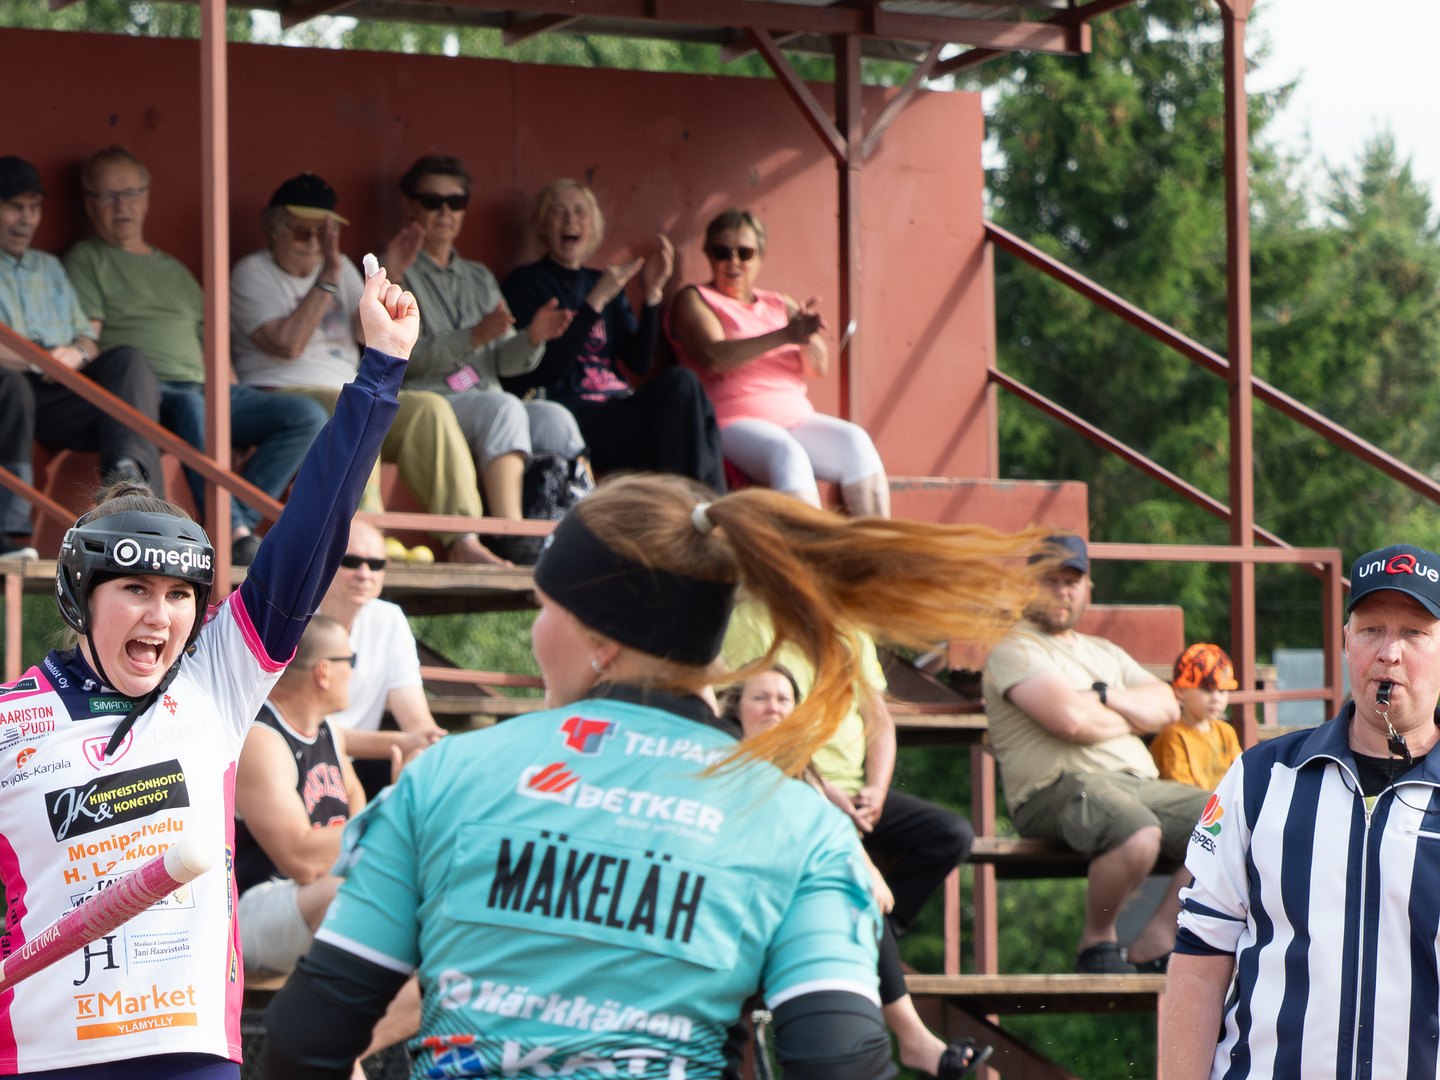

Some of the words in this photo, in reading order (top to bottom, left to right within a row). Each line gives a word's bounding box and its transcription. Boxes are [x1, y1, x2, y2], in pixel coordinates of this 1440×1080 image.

[89, 772, 185, 805] KIINTEISTÖNHOITO
[113, 790, 169, 813] KONETYÖT
[574, 782, 725, 834] BETKER
[68, 817, 184, 862] Monipalvelu
[22, 924, 61, 960] ULTIMA
[134, 948, 149, 959] Jani
[150, 943, 190, 956] Haavistola
[118, 1017, 174, 1034] YLÄMYLLY
